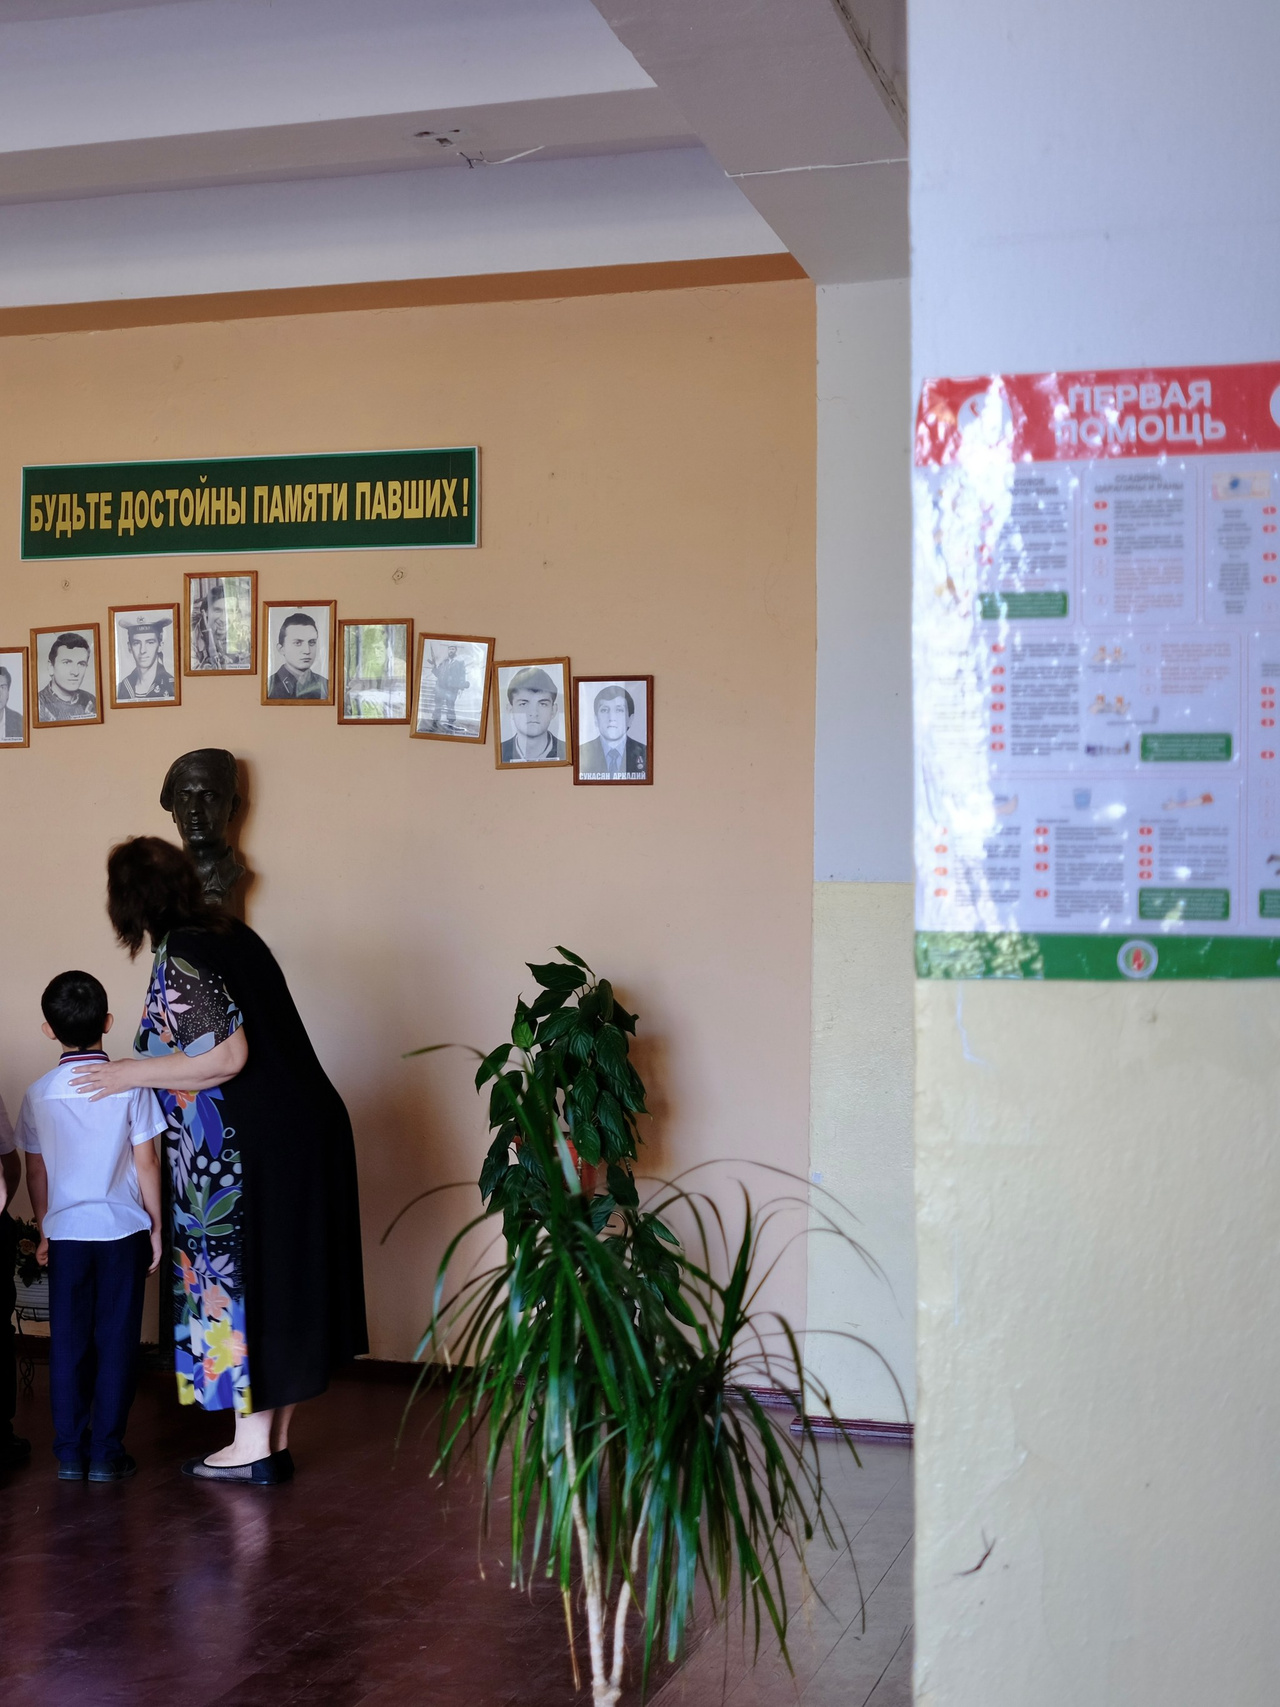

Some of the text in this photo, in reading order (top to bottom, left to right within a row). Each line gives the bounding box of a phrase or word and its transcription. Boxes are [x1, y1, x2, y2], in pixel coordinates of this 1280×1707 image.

[1068, 379, 1212, 413] ПЕРВАЯ
[1054, 412, 1227, 448] ПОМОЩЬ
[30, 492, 113, 538] БУДЬТЕ
[117, 475, 247, 537] ДОСТОЙНЫ
[253, 482, 348, 524] ПАМЯТИ
[579, 770, 646, 780] СУКАСЯН АРКАДИЙ
